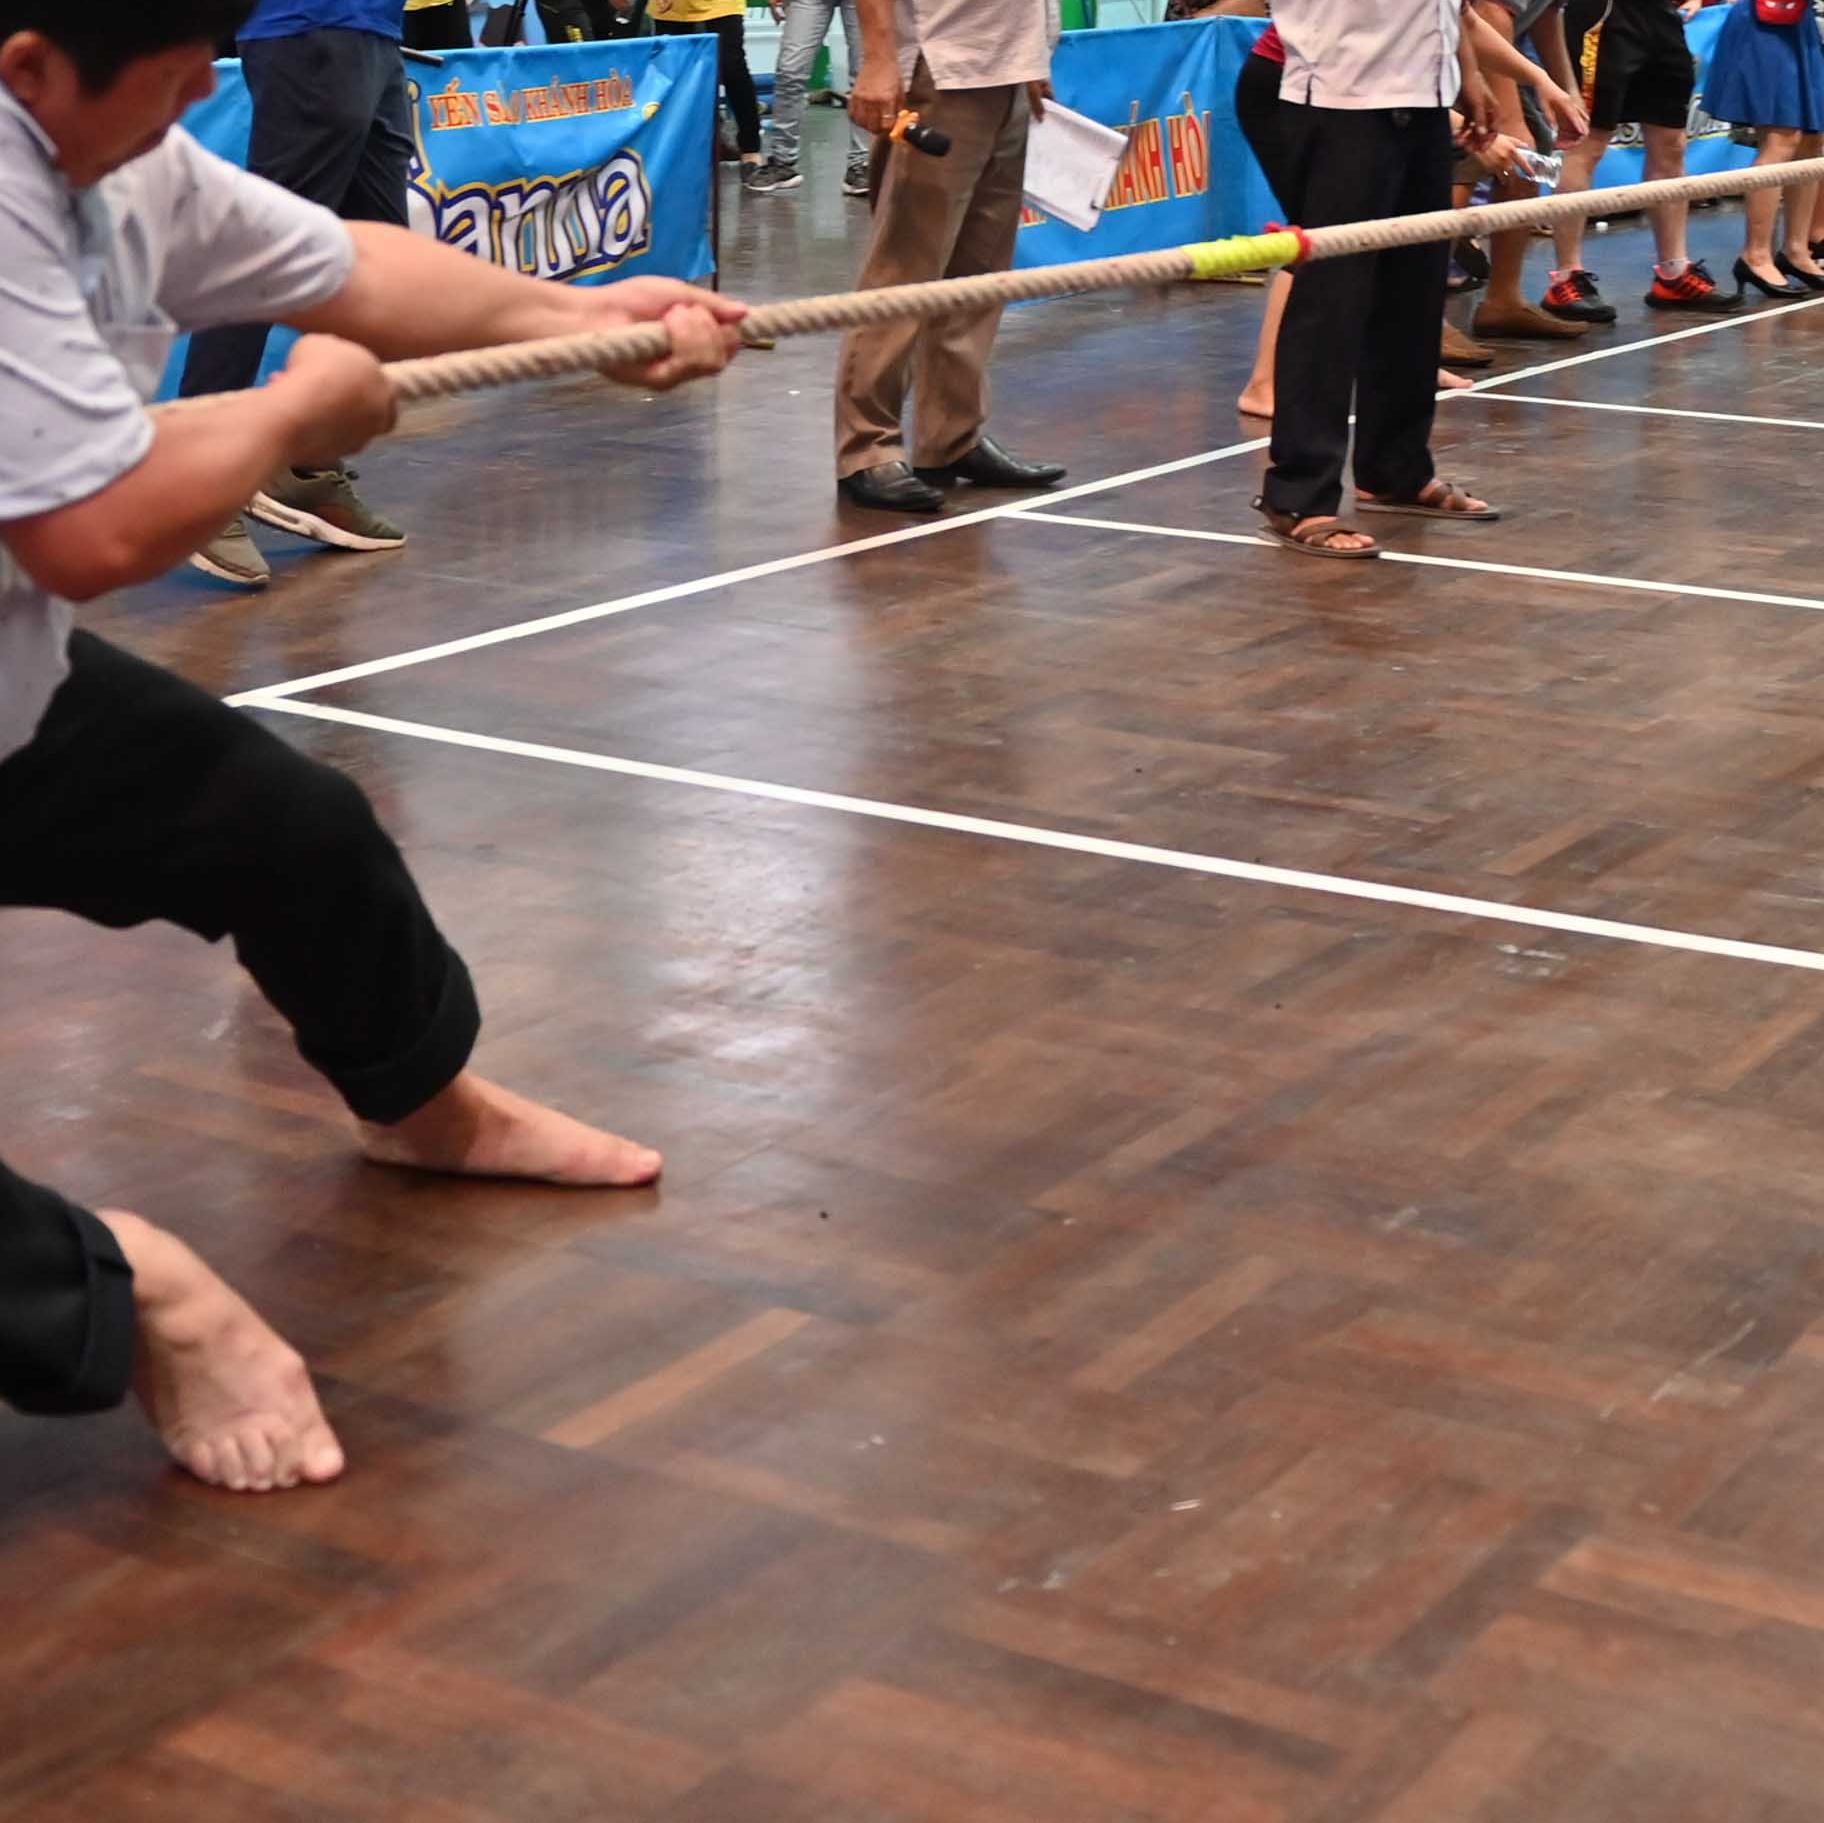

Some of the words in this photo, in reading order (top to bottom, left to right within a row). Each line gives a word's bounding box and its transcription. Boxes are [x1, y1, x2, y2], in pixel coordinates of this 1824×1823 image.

[428, 76, 483, 131] YẾN
[523, 75, 592, 124] KHÁNH
[594, 67, 637, 111] HÒA
